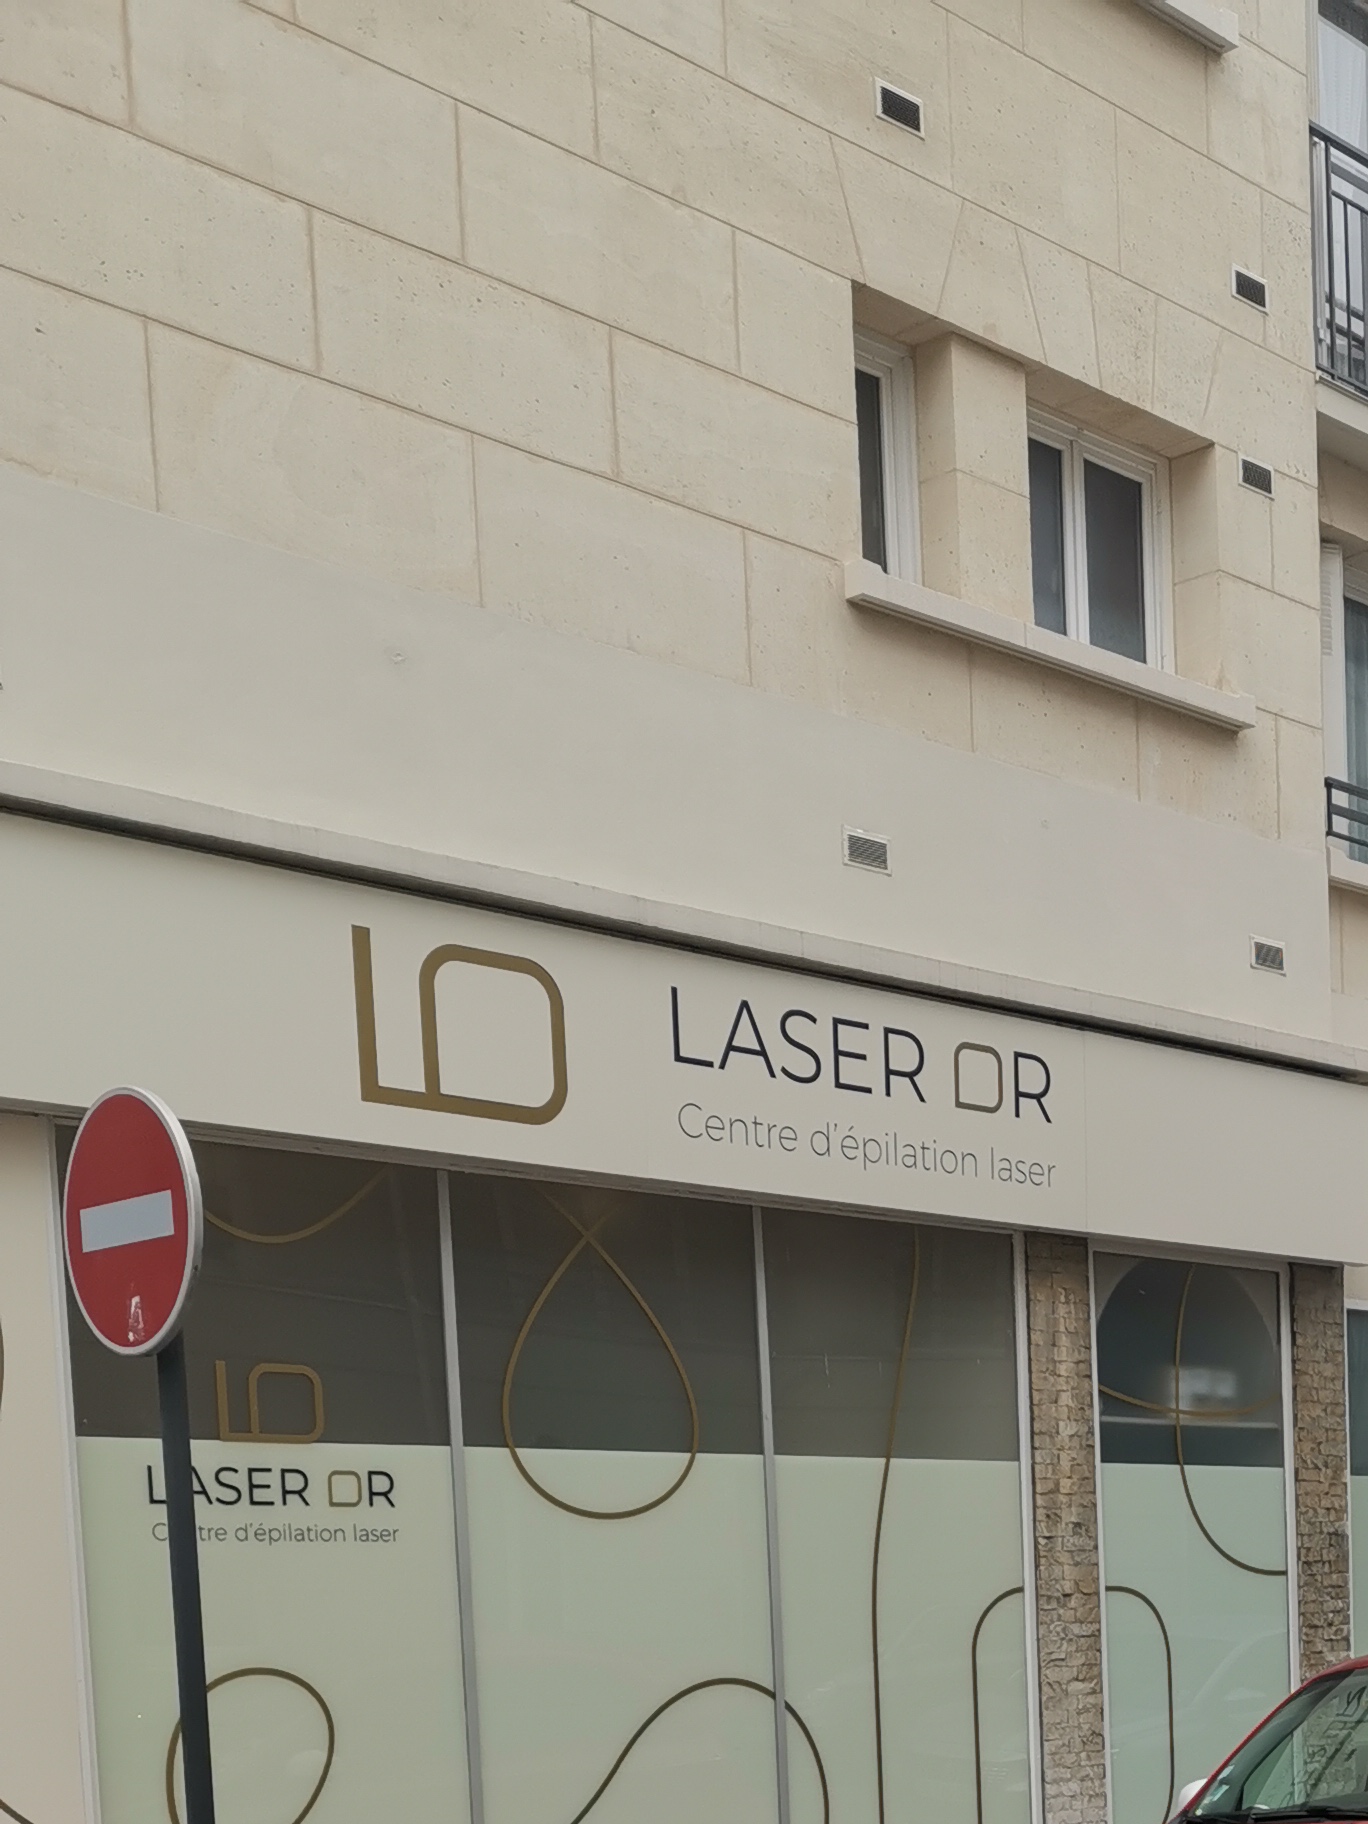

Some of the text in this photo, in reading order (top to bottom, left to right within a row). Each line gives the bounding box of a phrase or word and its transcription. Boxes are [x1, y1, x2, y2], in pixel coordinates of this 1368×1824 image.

[670, 985, 1053, 1124] LASER OR
[677, 1101, 1057, 1188] Centre d'épilation laser
[327, 1469, 396, 1509] OR
[151, 1522, 400, 1546] Ctre d'épilation laser
